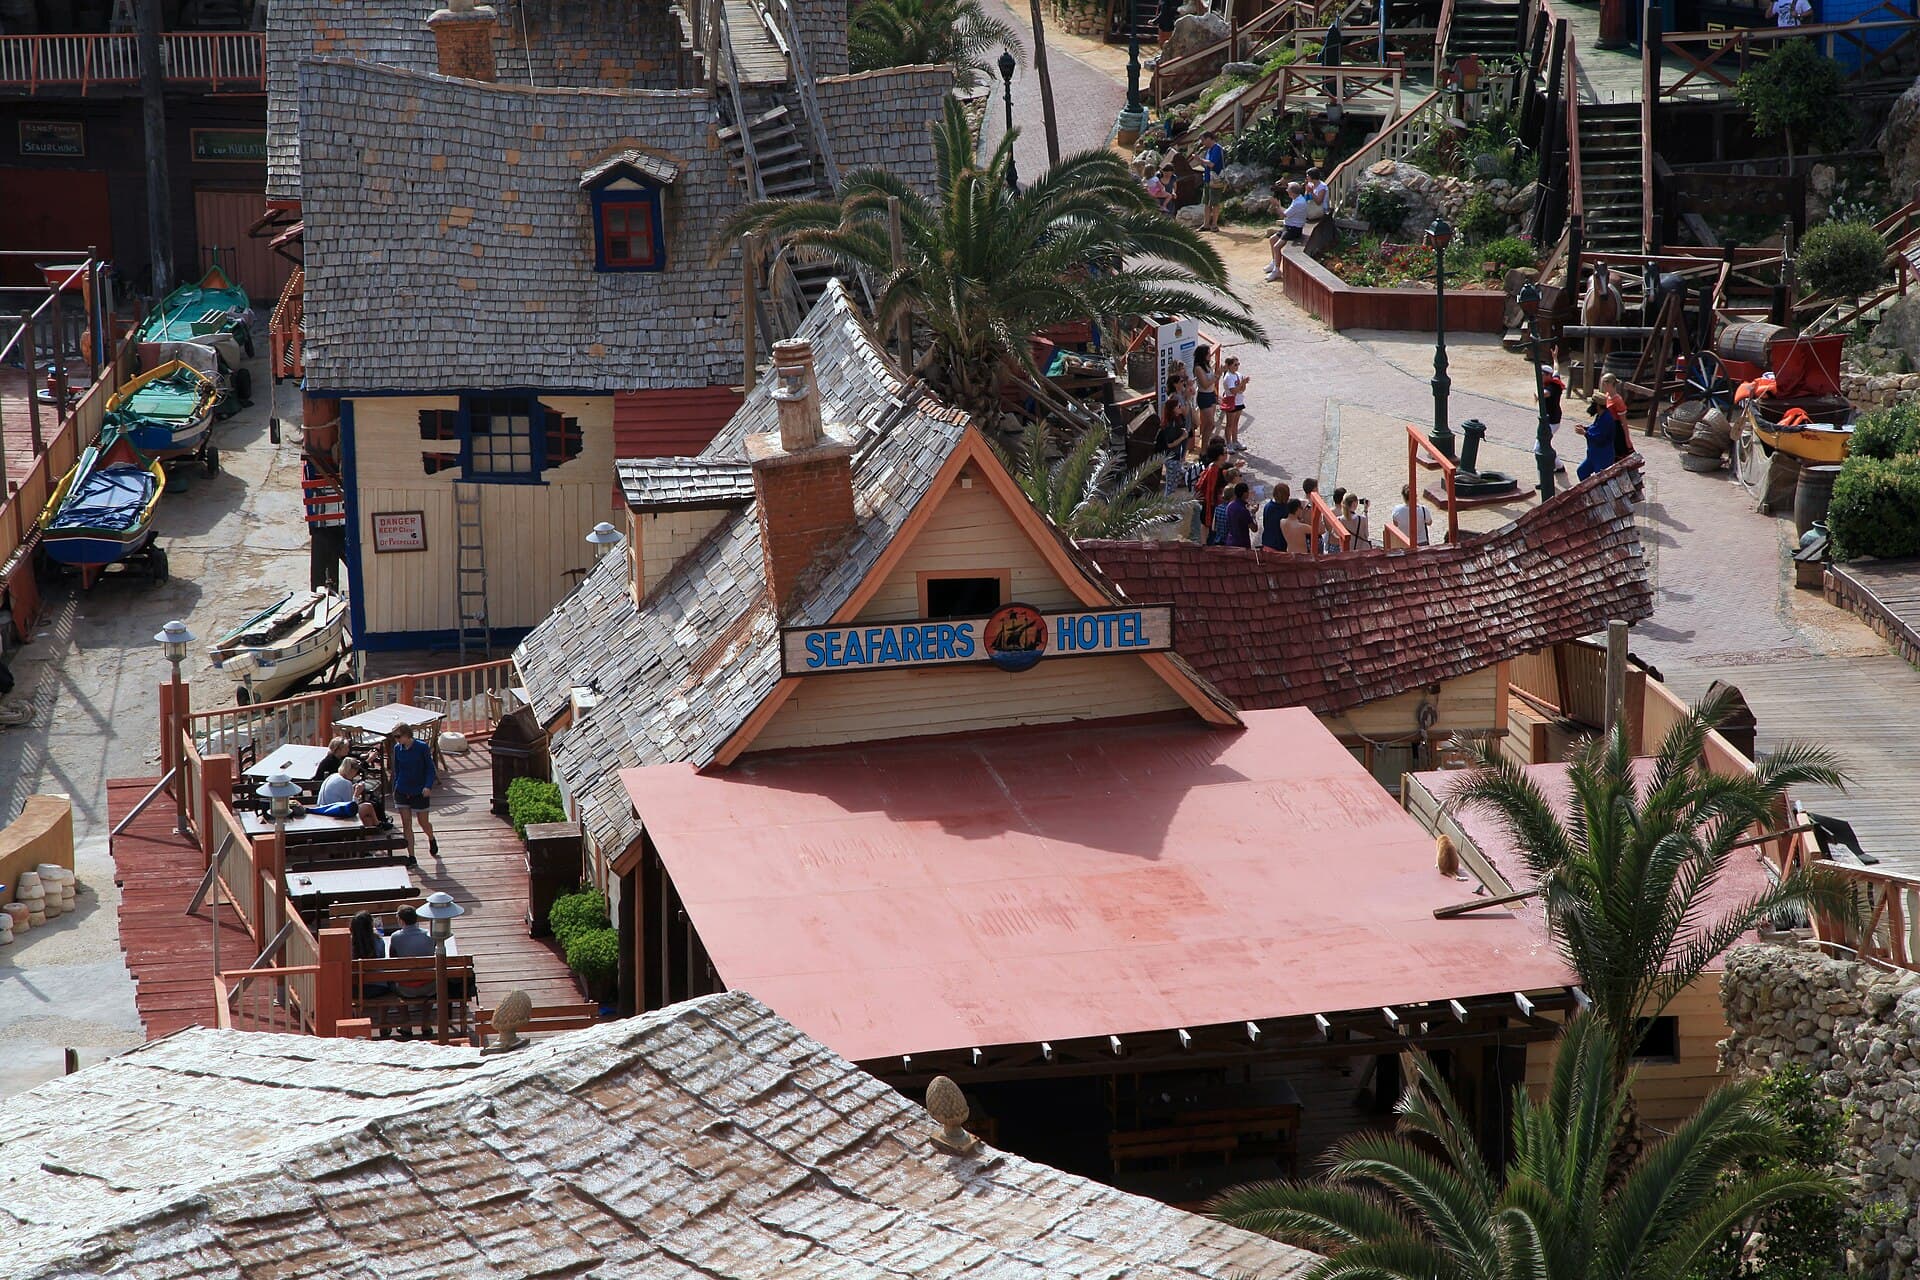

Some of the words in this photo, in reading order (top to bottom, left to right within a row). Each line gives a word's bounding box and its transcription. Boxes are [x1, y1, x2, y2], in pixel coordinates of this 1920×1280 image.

[380, 518, 416, 526] DANGER
[806, 623, 975, 668] SEAFARERS
[1057, 612, 1149, 651] HOTEL
